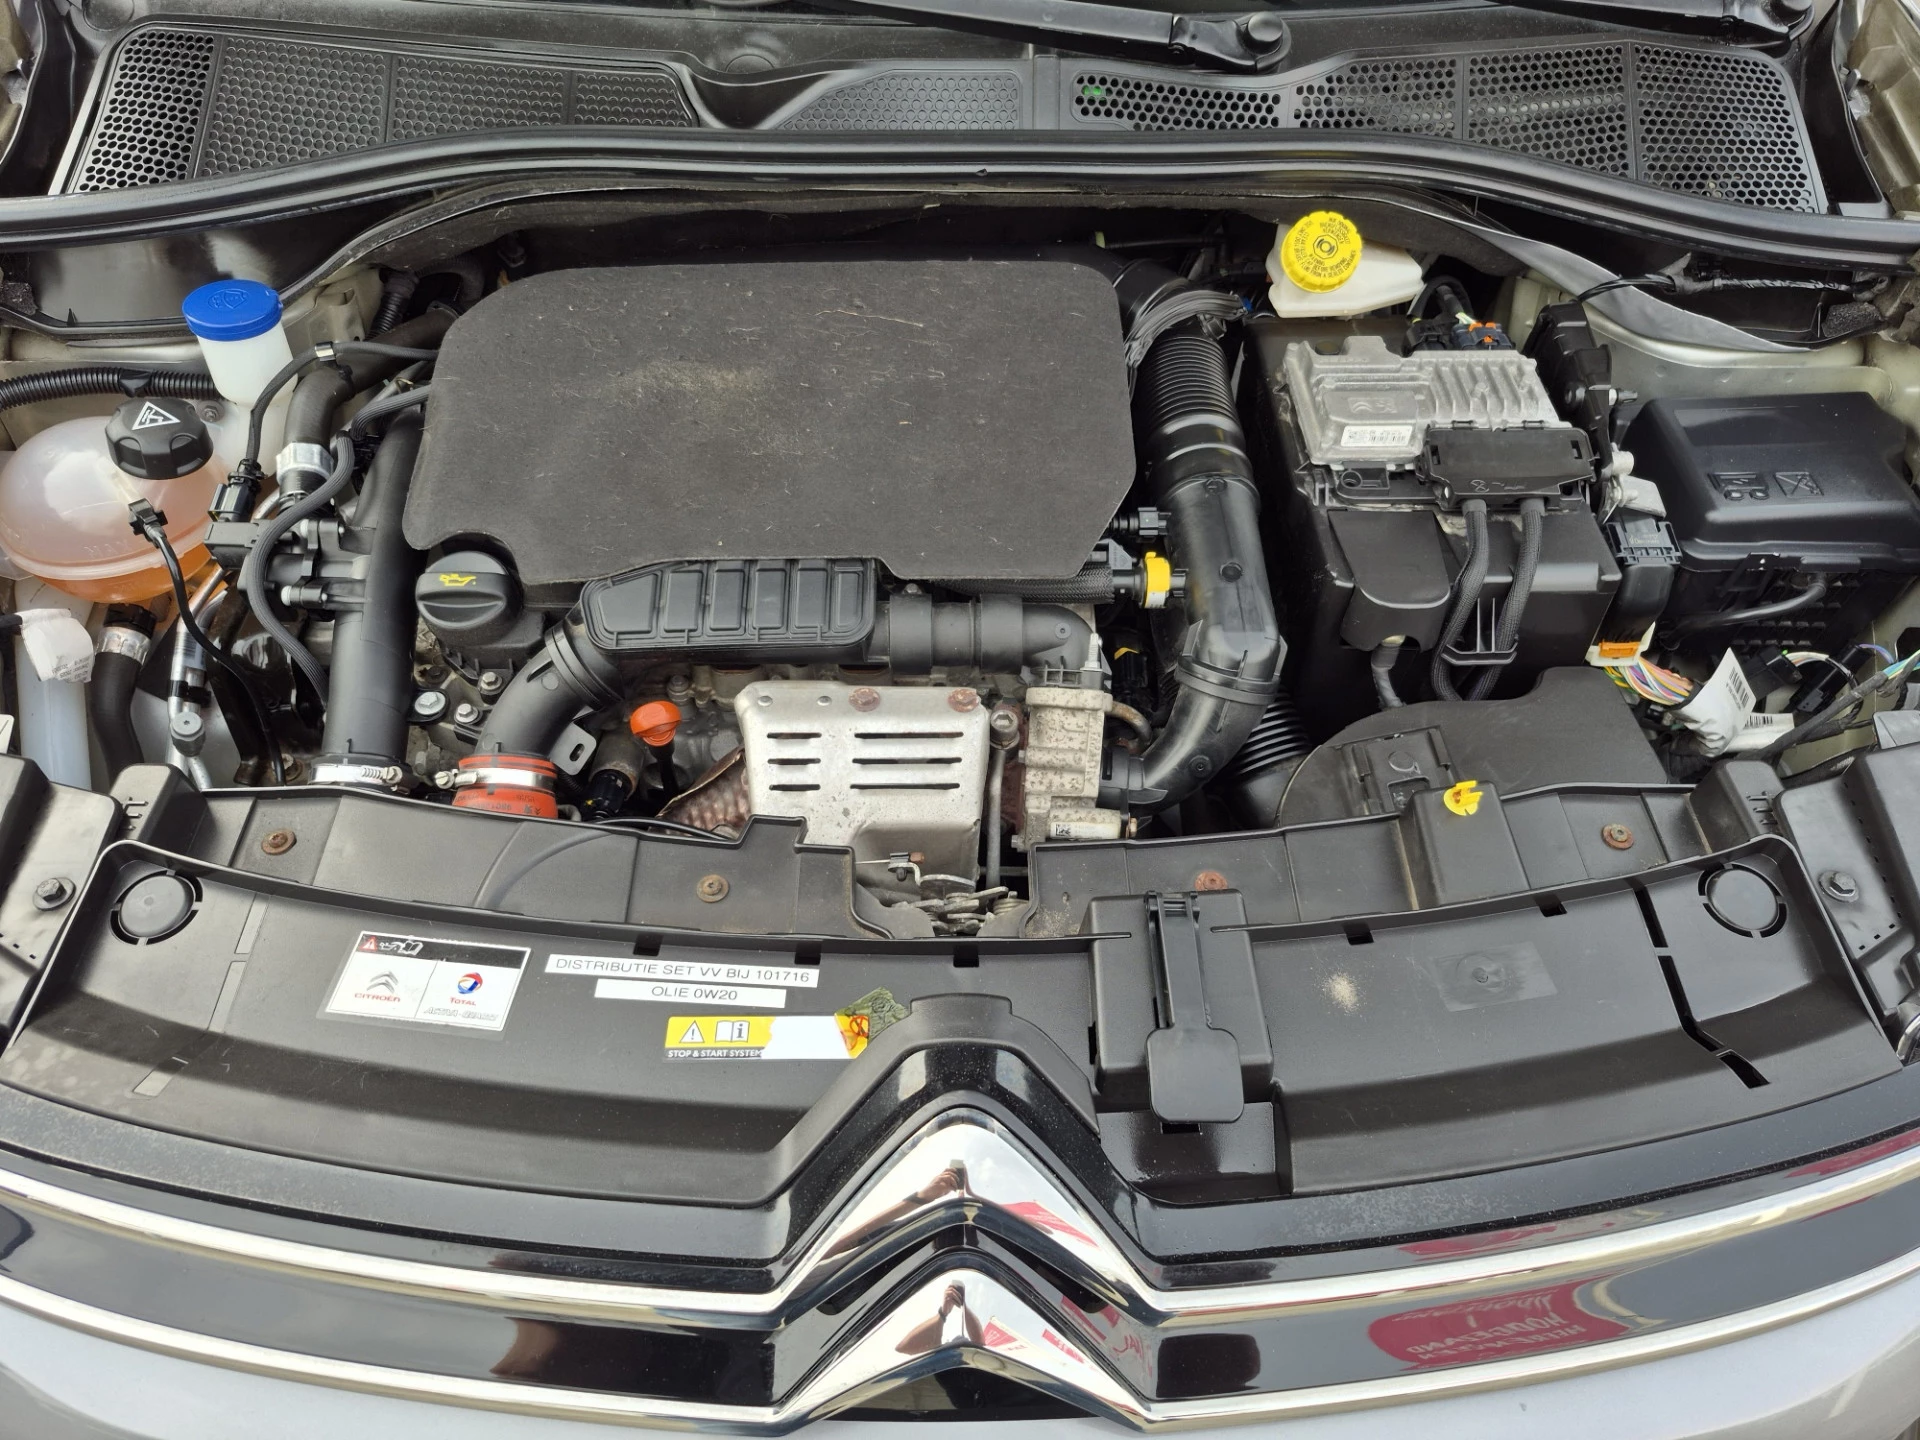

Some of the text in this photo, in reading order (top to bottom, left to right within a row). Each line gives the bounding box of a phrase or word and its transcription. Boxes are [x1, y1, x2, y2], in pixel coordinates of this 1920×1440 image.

[556, 958, 810, 983] DISTRIBUTIE SET VV BIJ 101716
[651, 986, 738, 1001] OLIE 0W20
[450, 997, 476, 1006] TOTAL
[668, 1049, 691, 1058] STOP
[692, 1049, 700, 1058] &
[700, 1049, 728, 1058] START
